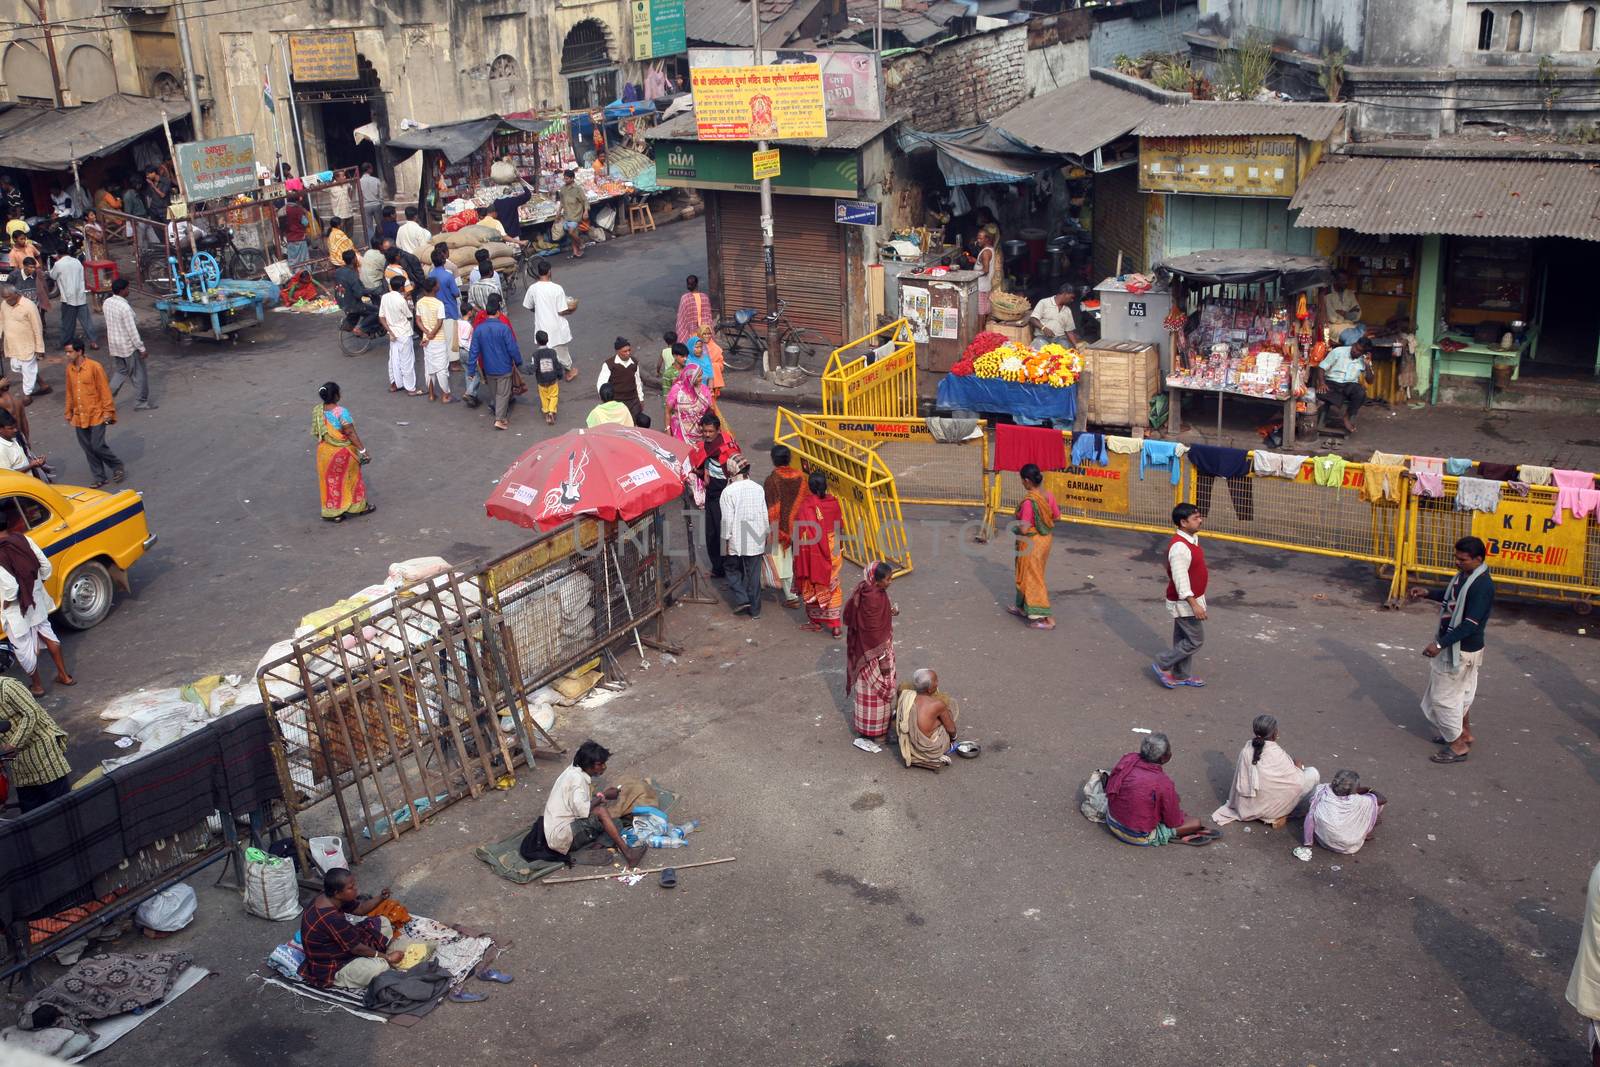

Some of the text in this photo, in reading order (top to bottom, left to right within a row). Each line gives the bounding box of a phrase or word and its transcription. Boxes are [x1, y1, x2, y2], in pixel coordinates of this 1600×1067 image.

[838, 422, 909, 433] BRAINWARE
[1067, 479, 1103, 493] GARIAHAT
[1501, 539, 1544, 555] BIRLA
[1500, 549, 1544, 564] TYRES
